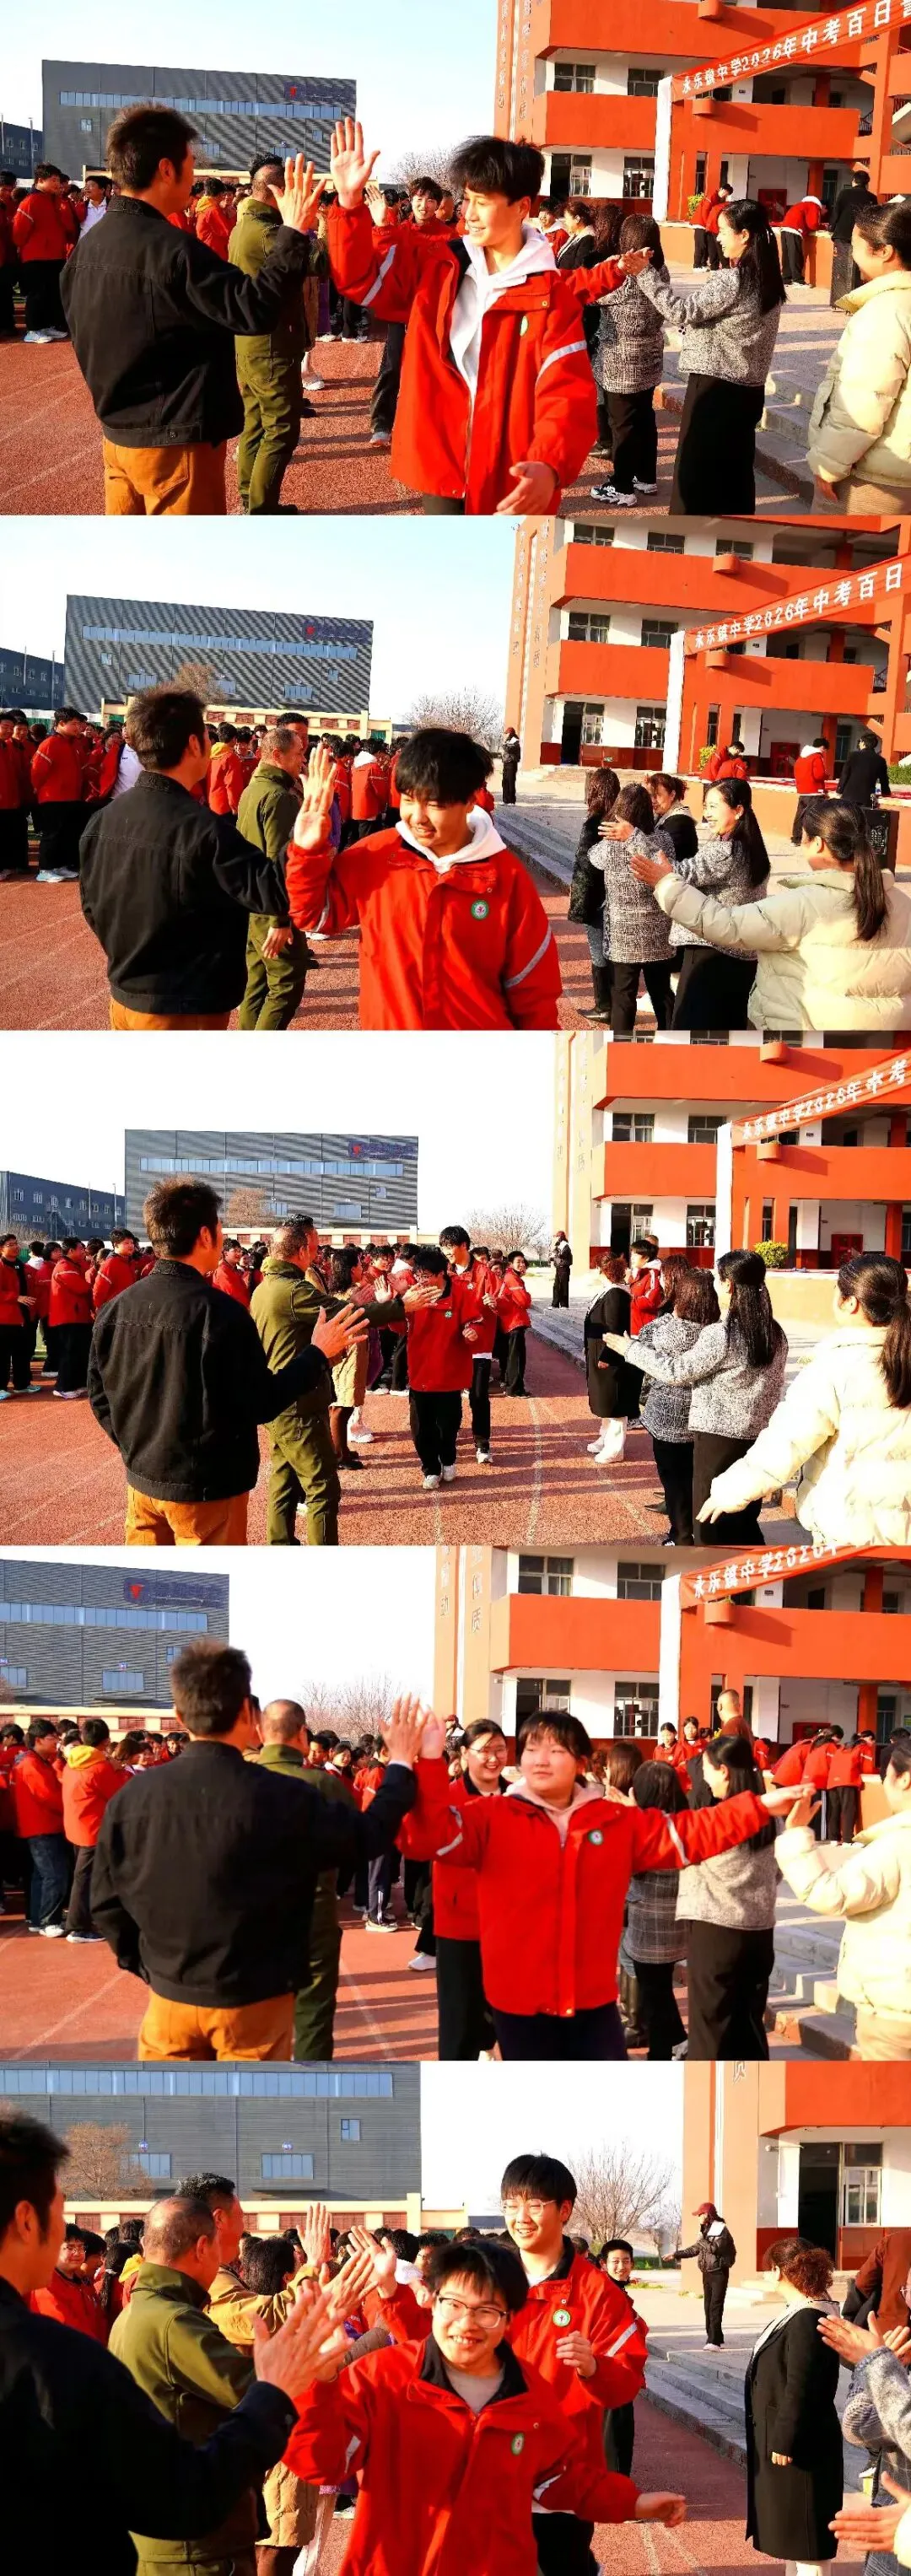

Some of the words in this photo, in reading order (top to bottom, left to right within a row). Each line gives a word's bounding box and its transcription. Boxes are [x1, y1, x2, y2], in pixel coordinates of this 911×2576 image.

[694, 563, 903, 648] 永乐镇中学2026年中考百日
